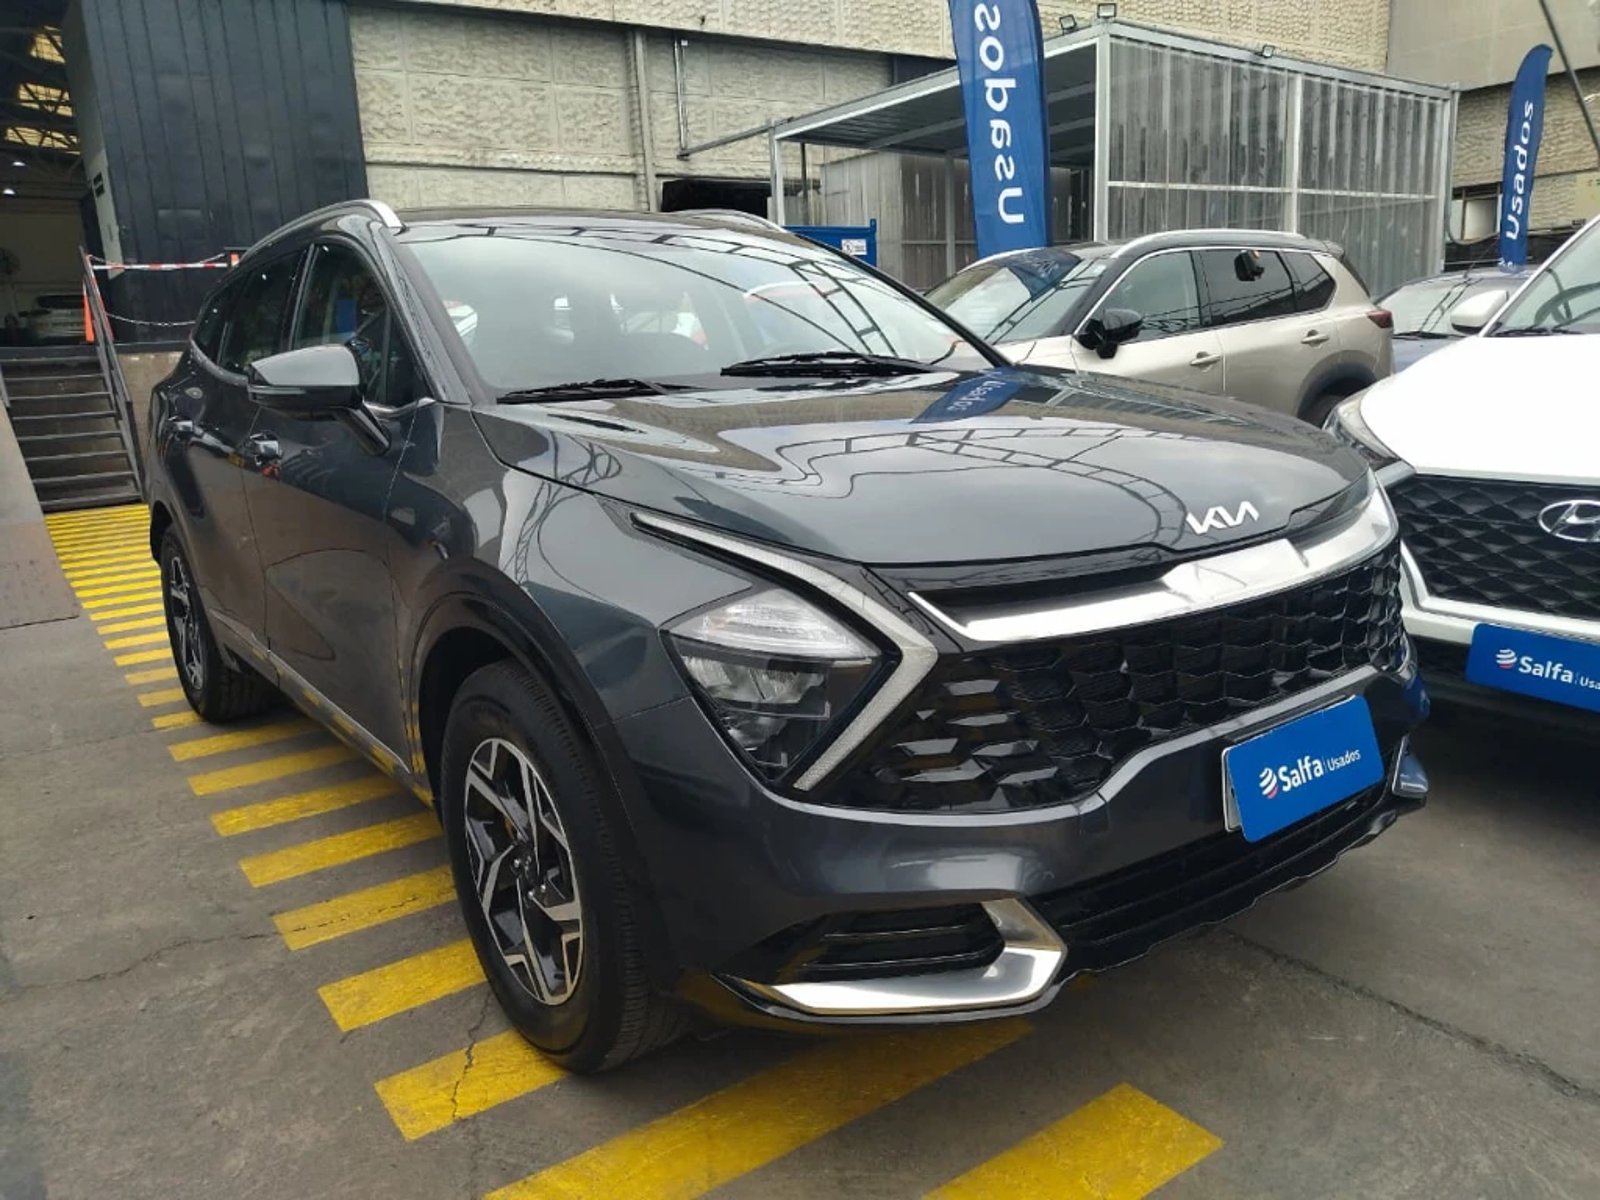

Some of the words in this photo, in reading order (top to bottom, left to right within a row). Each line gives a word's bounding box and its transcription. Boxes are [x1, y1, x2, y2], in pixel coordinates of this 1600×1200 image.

[1505, 99, 1534, 241] Usados
[1186, 500, 1260, 534] KIA
[1518, 655, 1574, 684] Salfa
[1278, 755, 1324, 792] Salfa
[1326, 749, 1361, 772] Usados
